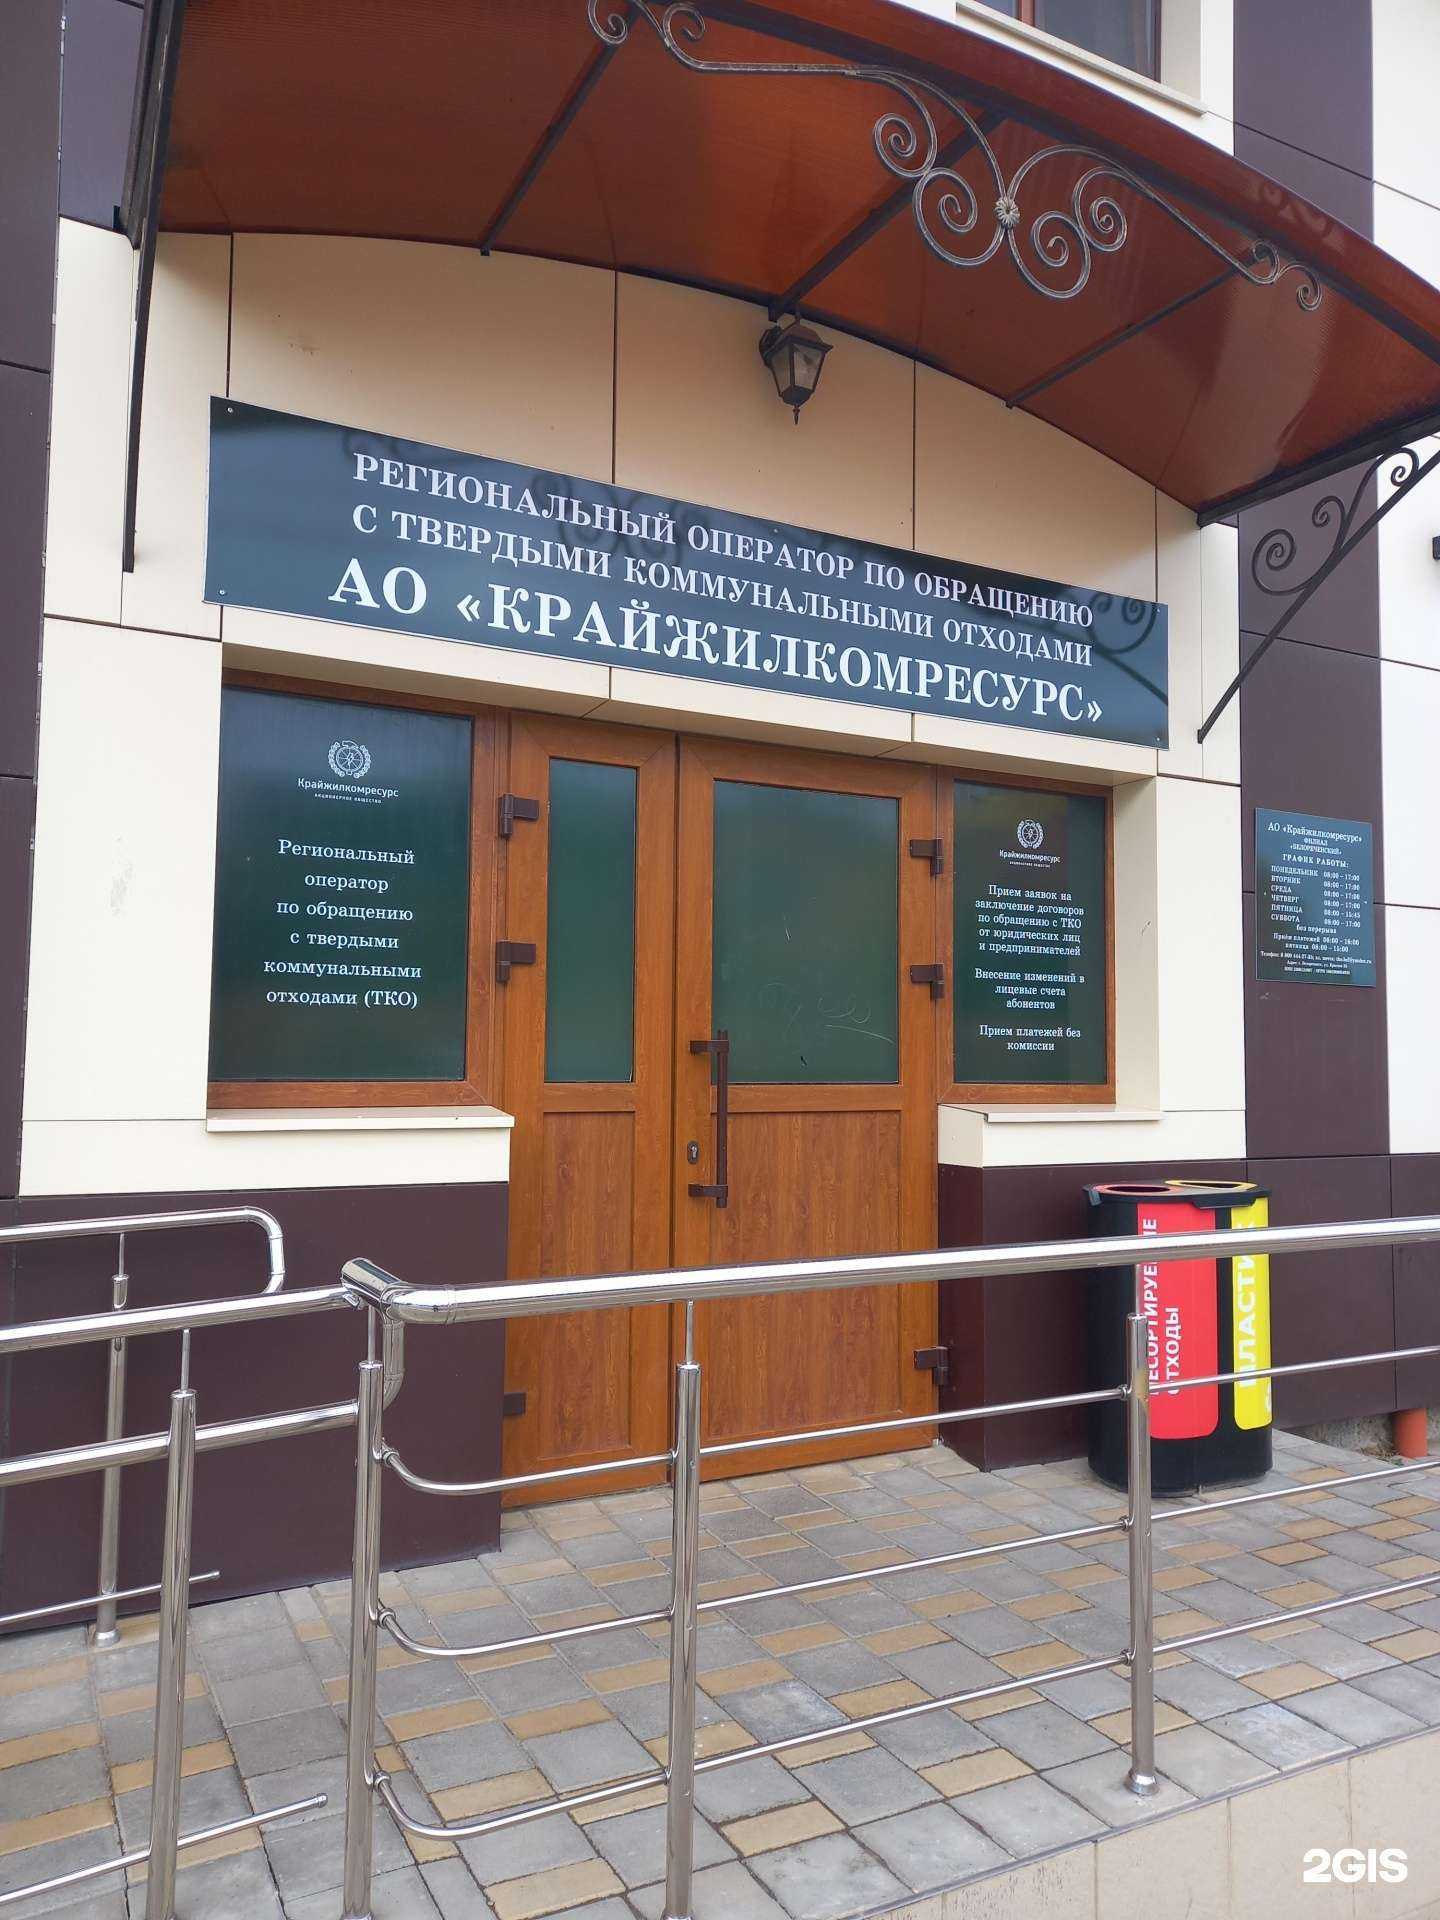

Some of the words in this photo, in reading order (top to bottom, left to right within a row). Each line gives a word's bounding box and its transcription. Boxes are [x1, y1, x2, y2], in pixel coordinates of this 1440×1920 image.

[353, 452, 676, 544] РЕГИОНАЛЬНЫЙ
[687, 525, 854, 580] ОПЕРАТОР
[863, 560, 905, 591] ПО
[914, 571, 1094, 628] ОБРАЩЕНИЮ
[352, 504, 378, 534] С
[391, 510, 611, 579] ТВЕРДЫМИ
[623, 556, 934, 639] КОММУНАЛЬНЫМИ
[943, 618, 1093, 667] ОТХОДАМИ
[328, 558, 427, 615] АО
[456, 583, 1103, 723] «КРАЙЖИЛКОМРЕСУРС»
[298, 778, 399, 798] Крайжилкомресурс
[1268, 822, 1280, 831] АО
[278, 839, 415, 865] Региональный
[999, 849, 1061, 864] Крайжилкомресурс
[1282, 854, 1314, 864] ГРАФИК
[1316, 858, 1349, 868] РАБОТЫ:
[1271, 866, 1318, 876] ПОНЕДЕЛЬНИК
[304, 874, 389, 894] оператор
[1271, 875, 1300, 884] ВТОРНИК
[989, 885, 1022, 898] Прием
[1024, 889, 1058, 900] заявок
[1060, 893, 1072, 901] на
[1271, 885, 1292, 893] СРЕДА
[1271, 894, 1300, 903] ЧЕТВЕРГ
[276, 901, 300, 915] по
[306, 900, 413, 922] обращению
[975, 900, 1034, 912] заключение
[1037, 905, 1084, 917] договоров
[1271, 904, 1303, 913] ПЯТНИЦА
[978, 914, 990, 923] по
[993, 913, 1050, 927] обращению
[1052, 920, 1058, 928] с
[1060, 917, 1082, 929] ТКО
[1271, 914, 1301, 923] СУББОТА
[290, 932, 300, 944] с
[306, 932, 400, 950] твердыми
[979, 928, 990, 937] от
[993, 928, 1059, 942] юридических
[1062, 934, 1080, 944] лиц
[979, 942, 986, 950] и
[989, 942, 1081, 956] предпринимателей
[263, 960, 422, 978] коммунальными
[975, 968, 1021, 981] Внесение
[1024, 972, 1076, 983] изменений
[1079, 975, 1085, 983] в
[995, 985, 1037, 996] лицевые
[1040, 987, 1066, 996] счета
[266, 990, 358, 1006] отходами
[364, 989, 418, 1010] (ТКО)
[1006, 998, 1056, 1010] абонентов
[980, 1025, 1013, 1038] Прием
[1016, 1026, 1063, 1038] платежей
[1066, 1027, 1081, 1038] без
[1007, 1042, 1055, 1051] комиссии
[1236, 1223, 1257, 1389] ПЛАСТИ
